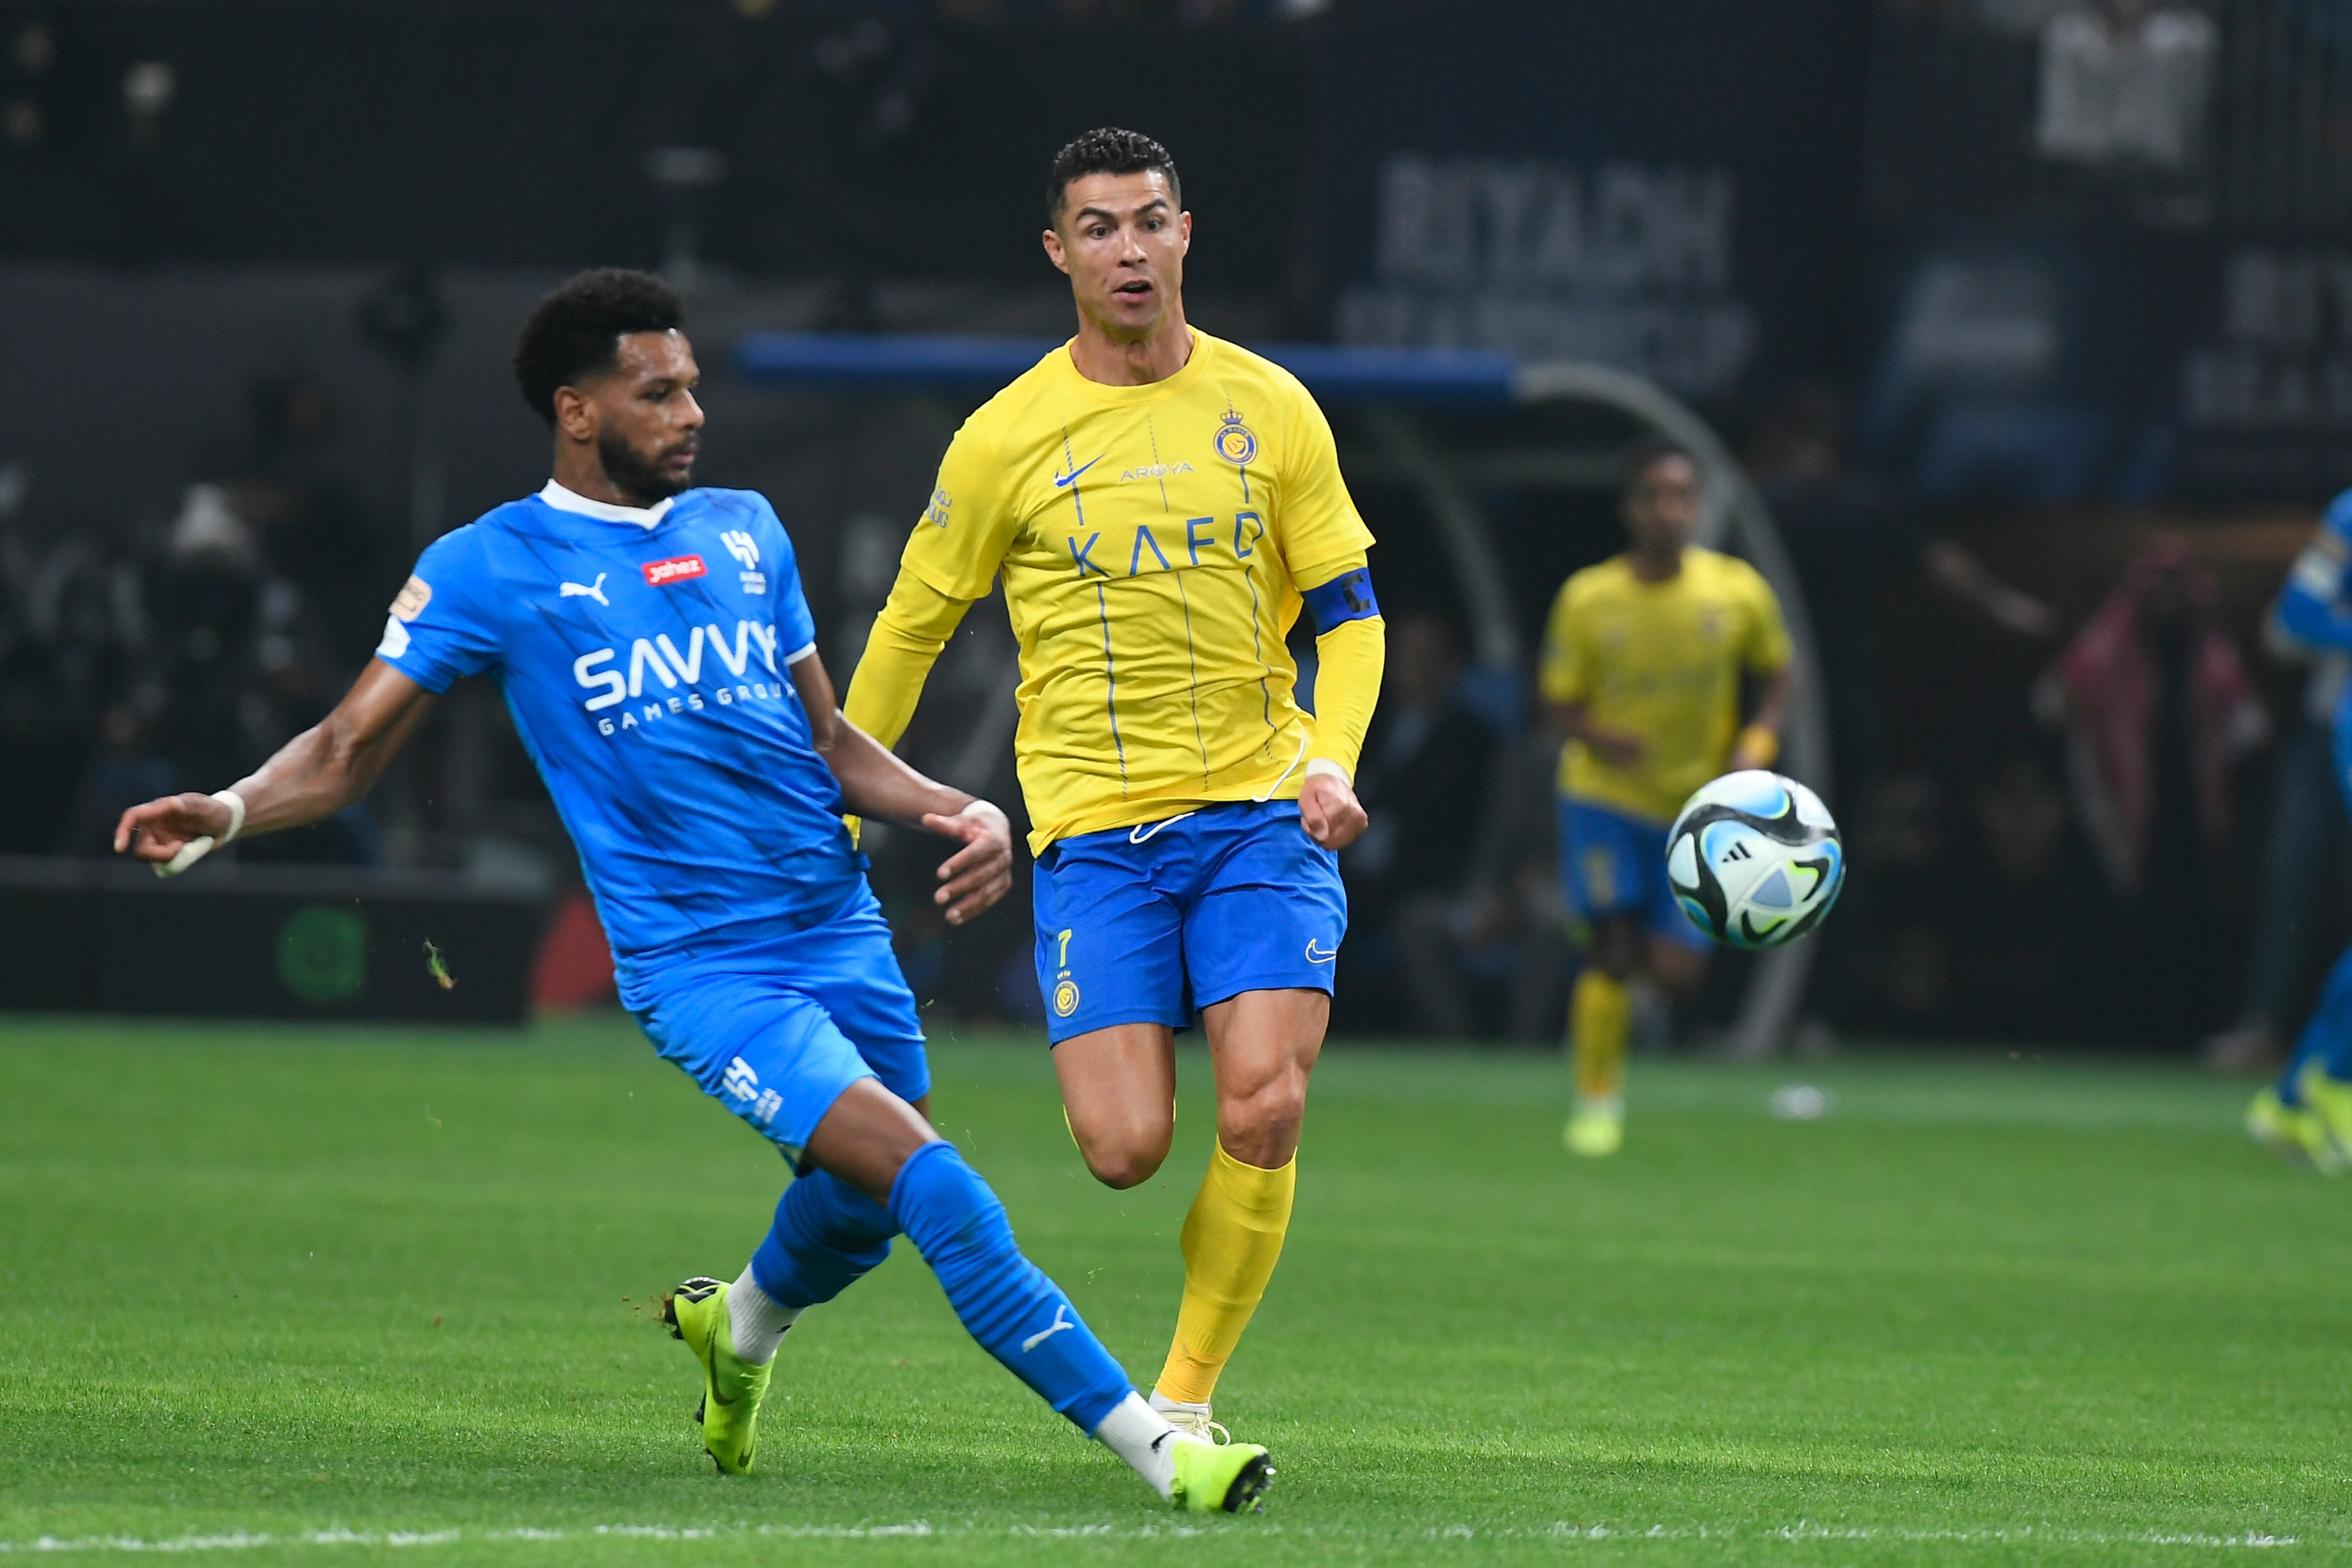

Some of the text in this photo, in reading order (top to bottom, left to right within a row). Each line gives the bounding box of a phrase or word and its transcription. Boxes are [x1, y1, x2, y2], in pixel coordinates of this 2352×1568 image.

[1120, 462, 1194, 482] AROYA
[1068, 511, 1264, 578] KAFD
[573, 620, 777, 711] SAVVY
[598, 693, 704, 736] GAMES
[1058, 928, 1072, 968] 7
